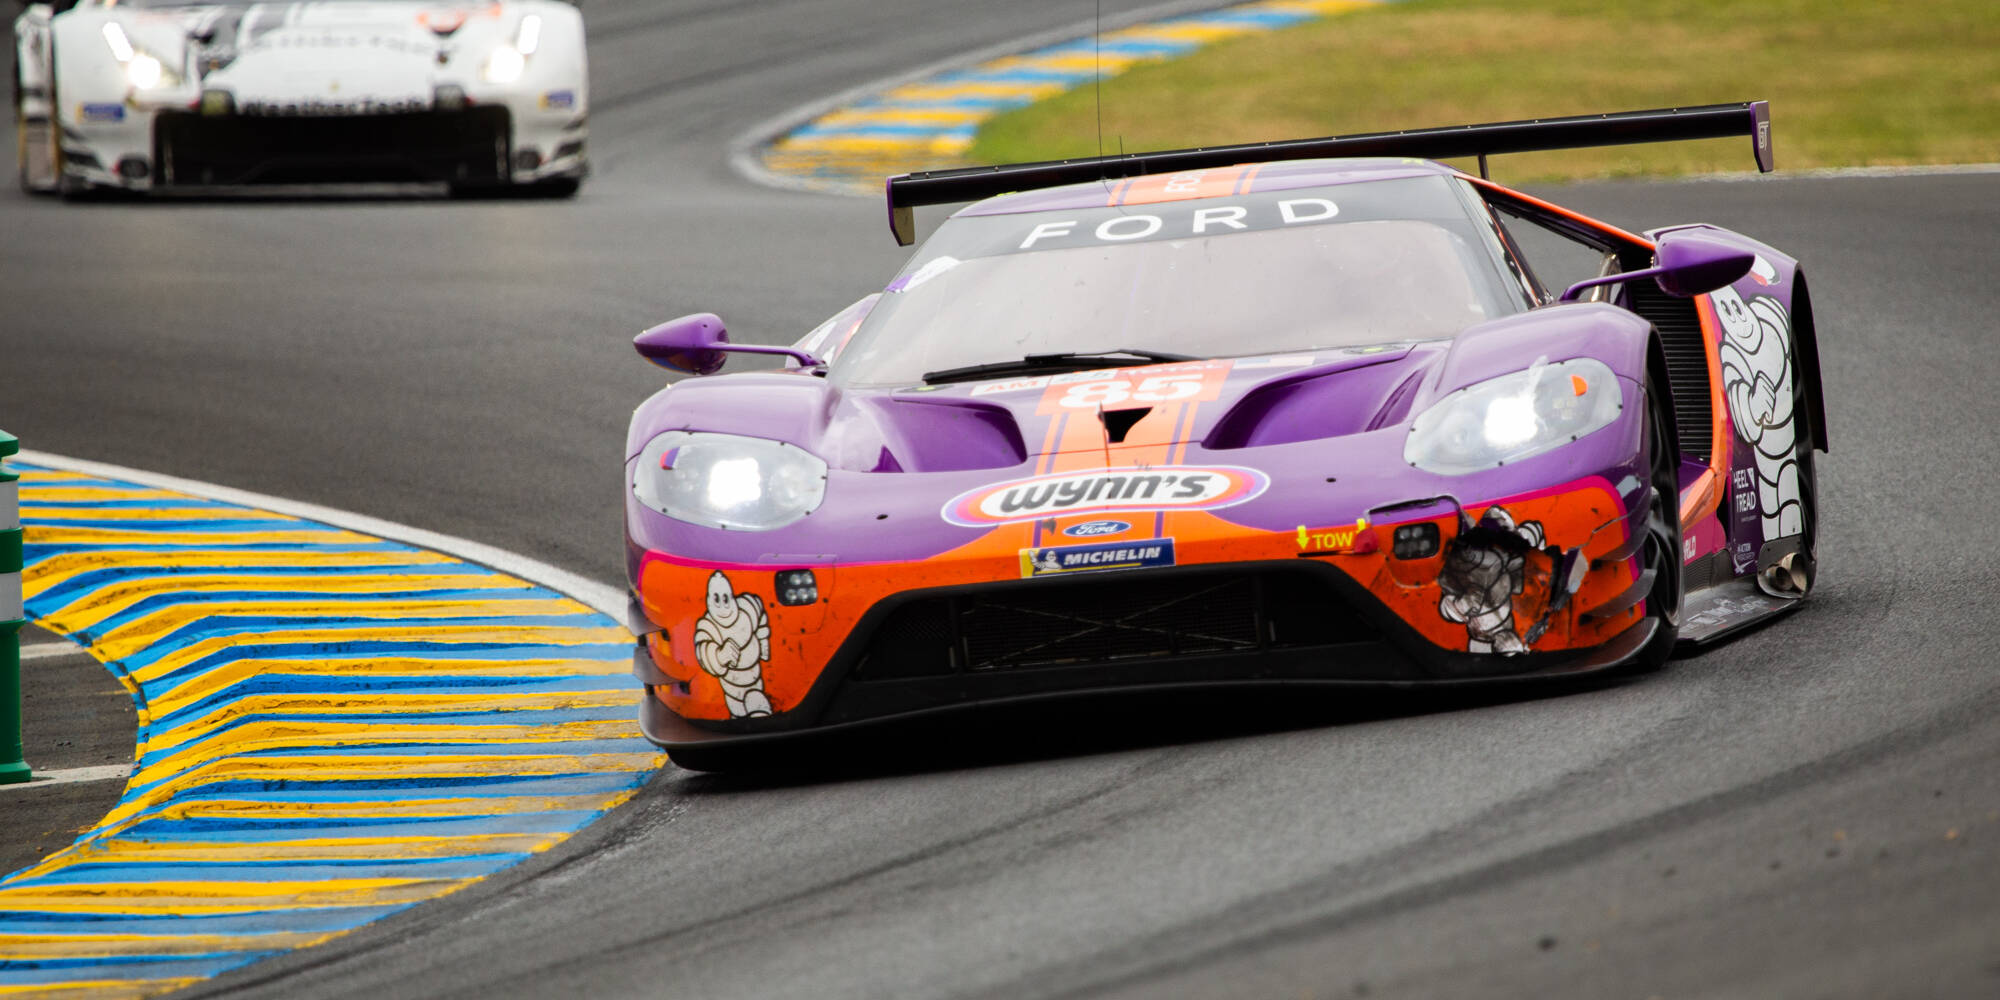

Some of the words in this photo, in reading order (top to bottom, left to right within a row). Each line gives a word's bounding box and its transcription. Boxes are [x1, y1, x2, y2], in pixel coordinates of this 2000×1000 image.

[1018, 198, 1340, 249] FORD
[984, 378, 1040, 393] AM
[1058, 373, 1204, 408] 85
[1075, 521, 1119, 535] Ford
[1311, 532, 1353, 549] TOW
[1063, 546, 1161, 566] MICHELIN
